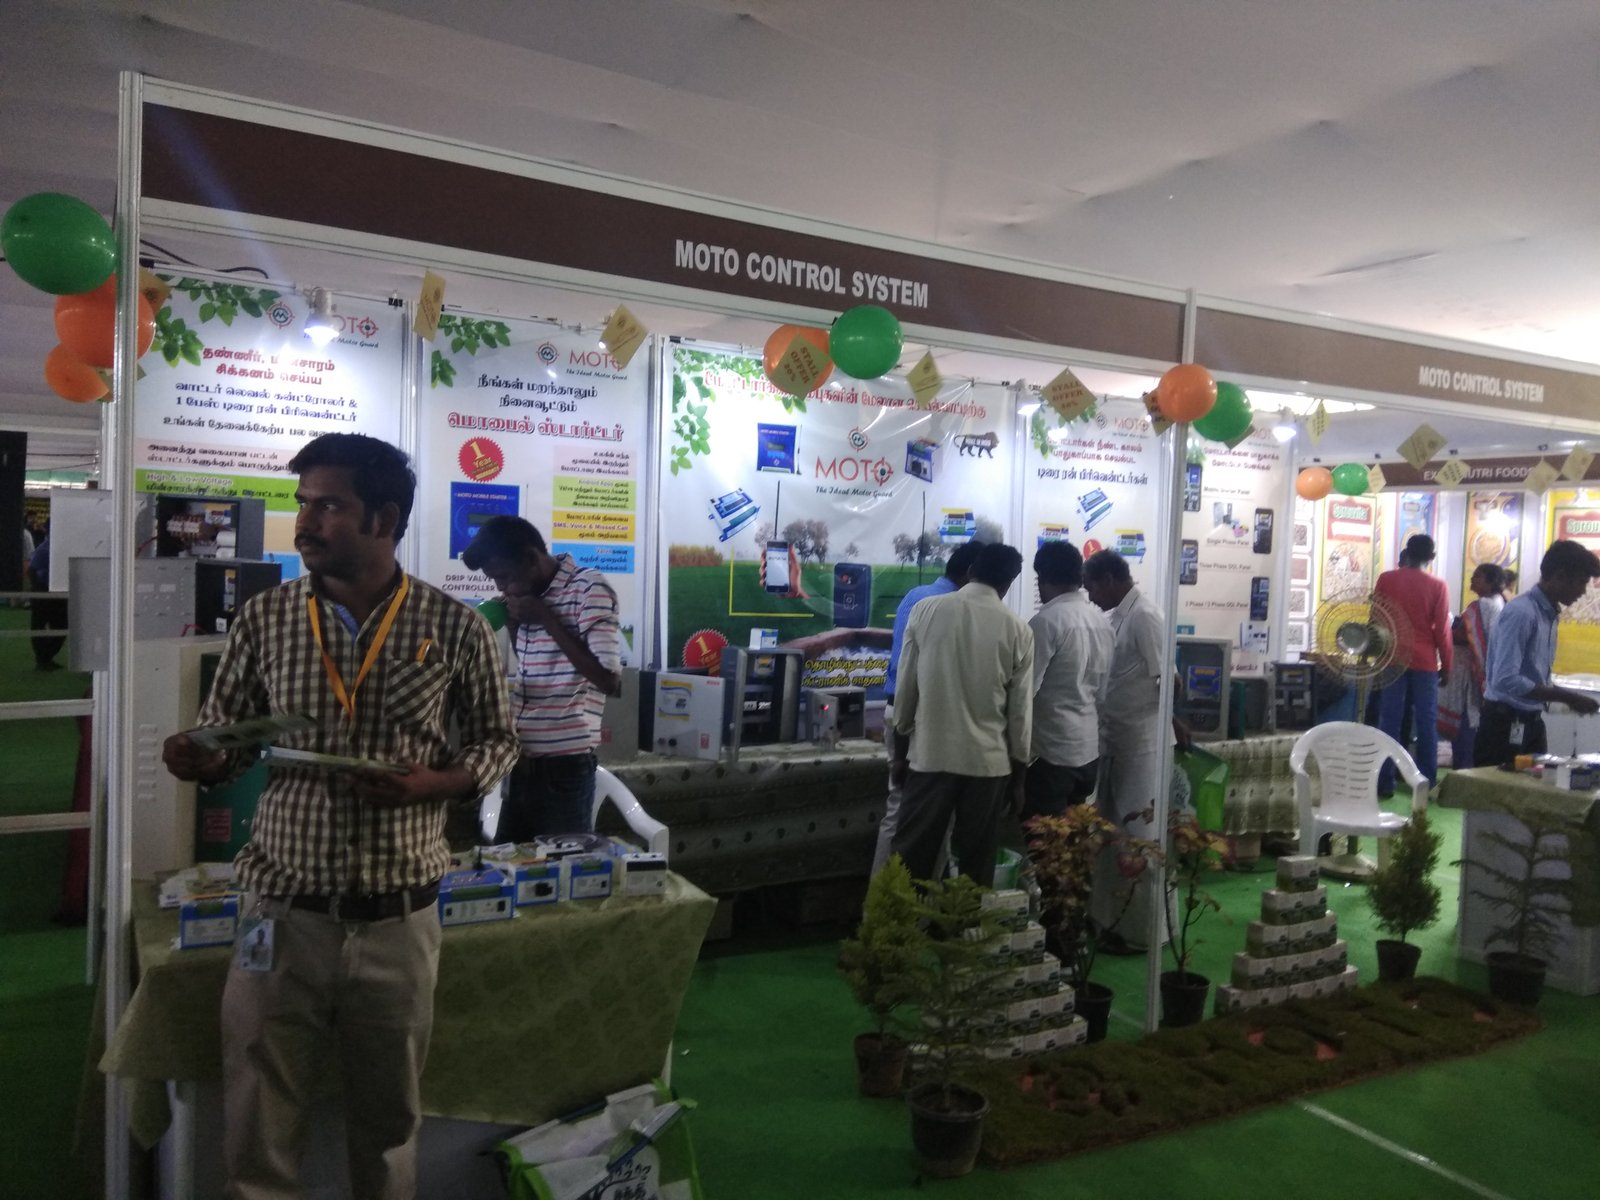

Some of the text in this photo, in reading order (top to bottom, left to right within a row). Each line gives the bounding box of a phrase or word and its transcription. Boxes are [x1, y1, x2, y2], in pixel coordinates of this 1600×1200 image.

[675, 239, 929, 309] MOTO CONTROL SYSTEM
[215, 363, 274, 380] சிக்கனம்
[477, 373, 598, 400] நீங்கள் மறந்தாலும்
[1418, 365, 1545, 403] MOTO CONTROL SYSTEM
[175, 381, 222, 395] வாட்டர்
[348, 399, 359, 409] &
[175, 396, 182, 406] 1
[162, 414, 206, 429] உங்கள்
[447, 410, 536, 435] மொபைல்
[469, 440, 486, 460] 1
[815, 455, 894, 487] MOTO
[850, 488, 872, 498] Motor
[442, 583, 496, 592] CONTROLLER
[445, 574, 466, 583] DRIP
[695, 635, 711, 657] 1
